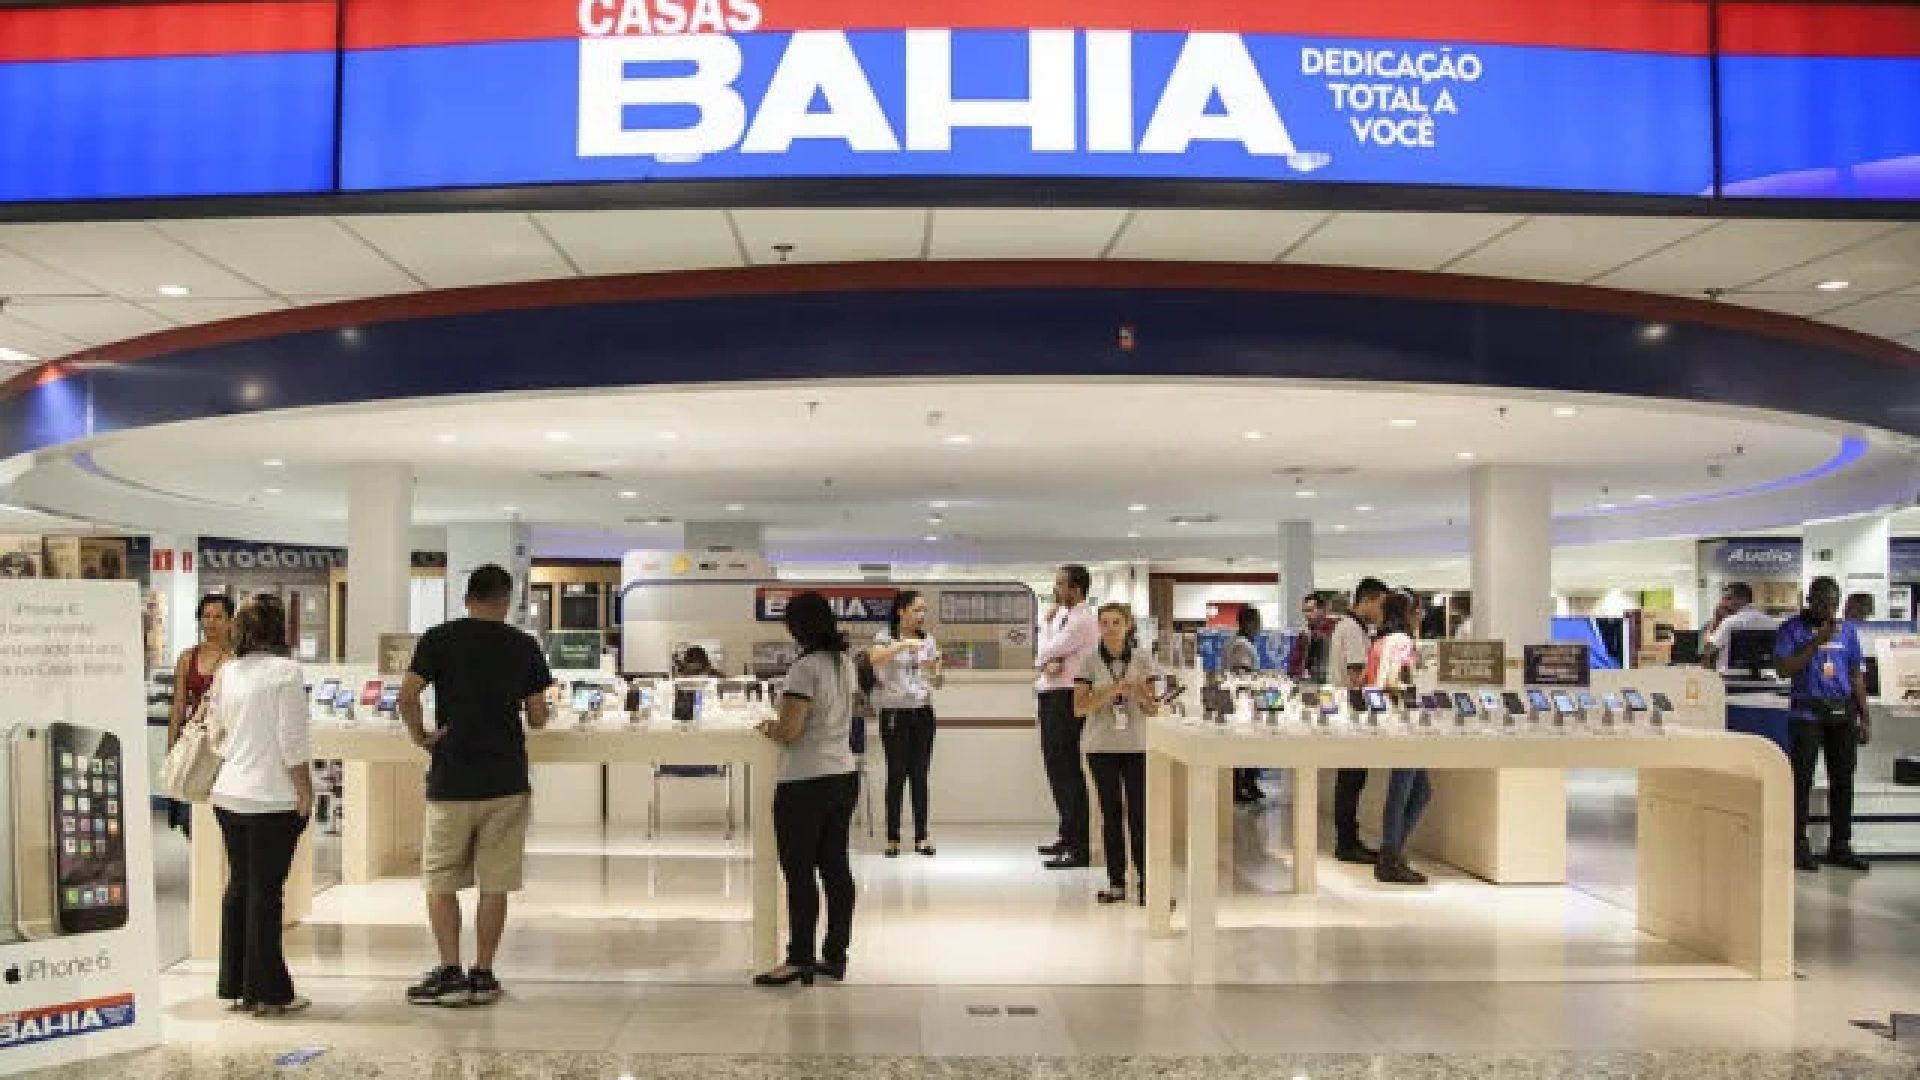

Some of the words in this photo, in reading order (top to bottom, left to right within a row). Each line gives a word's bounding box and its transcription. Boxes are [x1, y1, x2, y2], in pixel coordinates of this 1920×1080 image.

[577, 0, 763, 35] CASAS
[1301, 46, 1483, 83] DEDICAÇÃO
[576, 27, 1297, 157] BAHIA
[1328, 83, 1429, 112] TOTAL
[1433, 87, 1459, 114] A
[1350, 114, 1435, 148] VOCÊ
[26, 956, 94, 981] iPhone
[96, 948, 112, 970] 6
